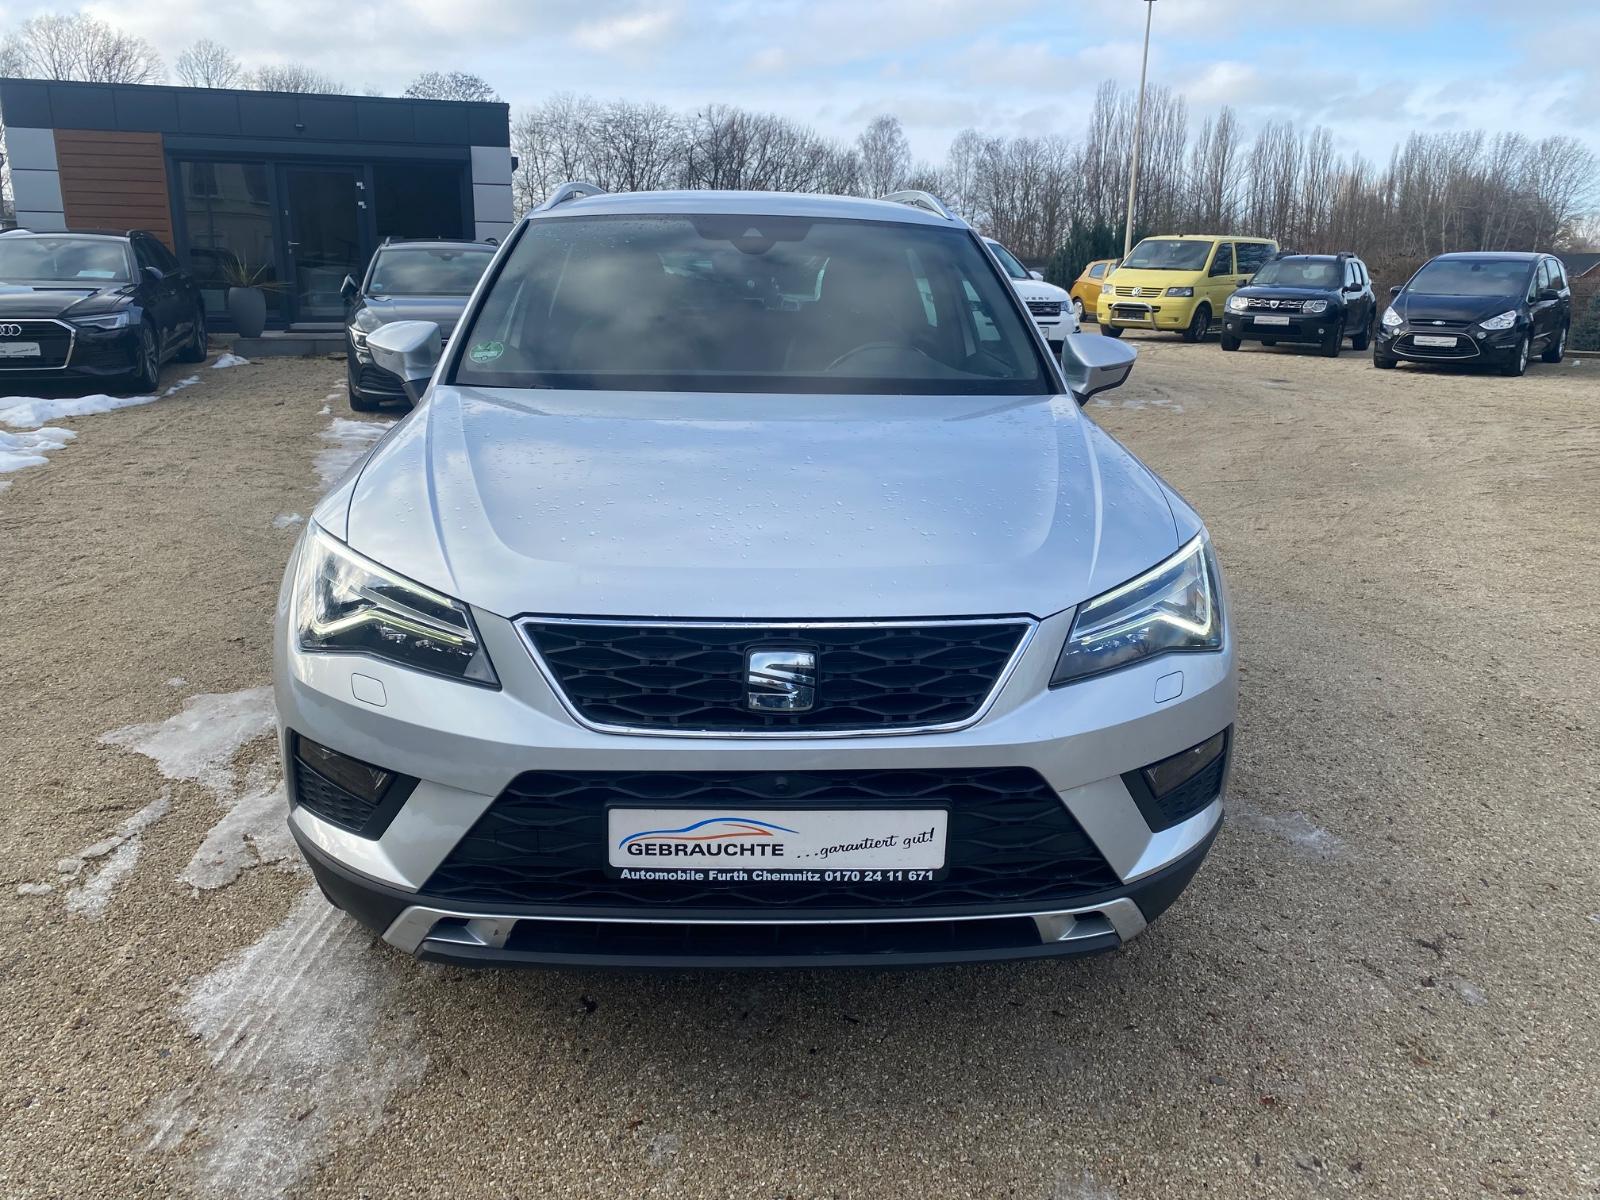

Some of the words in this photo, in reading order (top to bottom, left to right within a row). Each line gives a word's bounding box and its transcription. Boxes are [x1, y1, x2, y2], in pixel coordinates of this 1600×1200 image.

[903, 827, 935, 849] gut!
[627, 843, 784, 857] GEBRAUCHTE
[620, 868, 704, 881] Automobile
[708, 869, 748, 882] Furth
[752, 870, 821, 882] Chemnitz
[825, 871, 860, 882] 0170
[864, 871, 883, 882] 24
[887, 871, 903, 882] 11
[908, 871, 934, 882] 671
